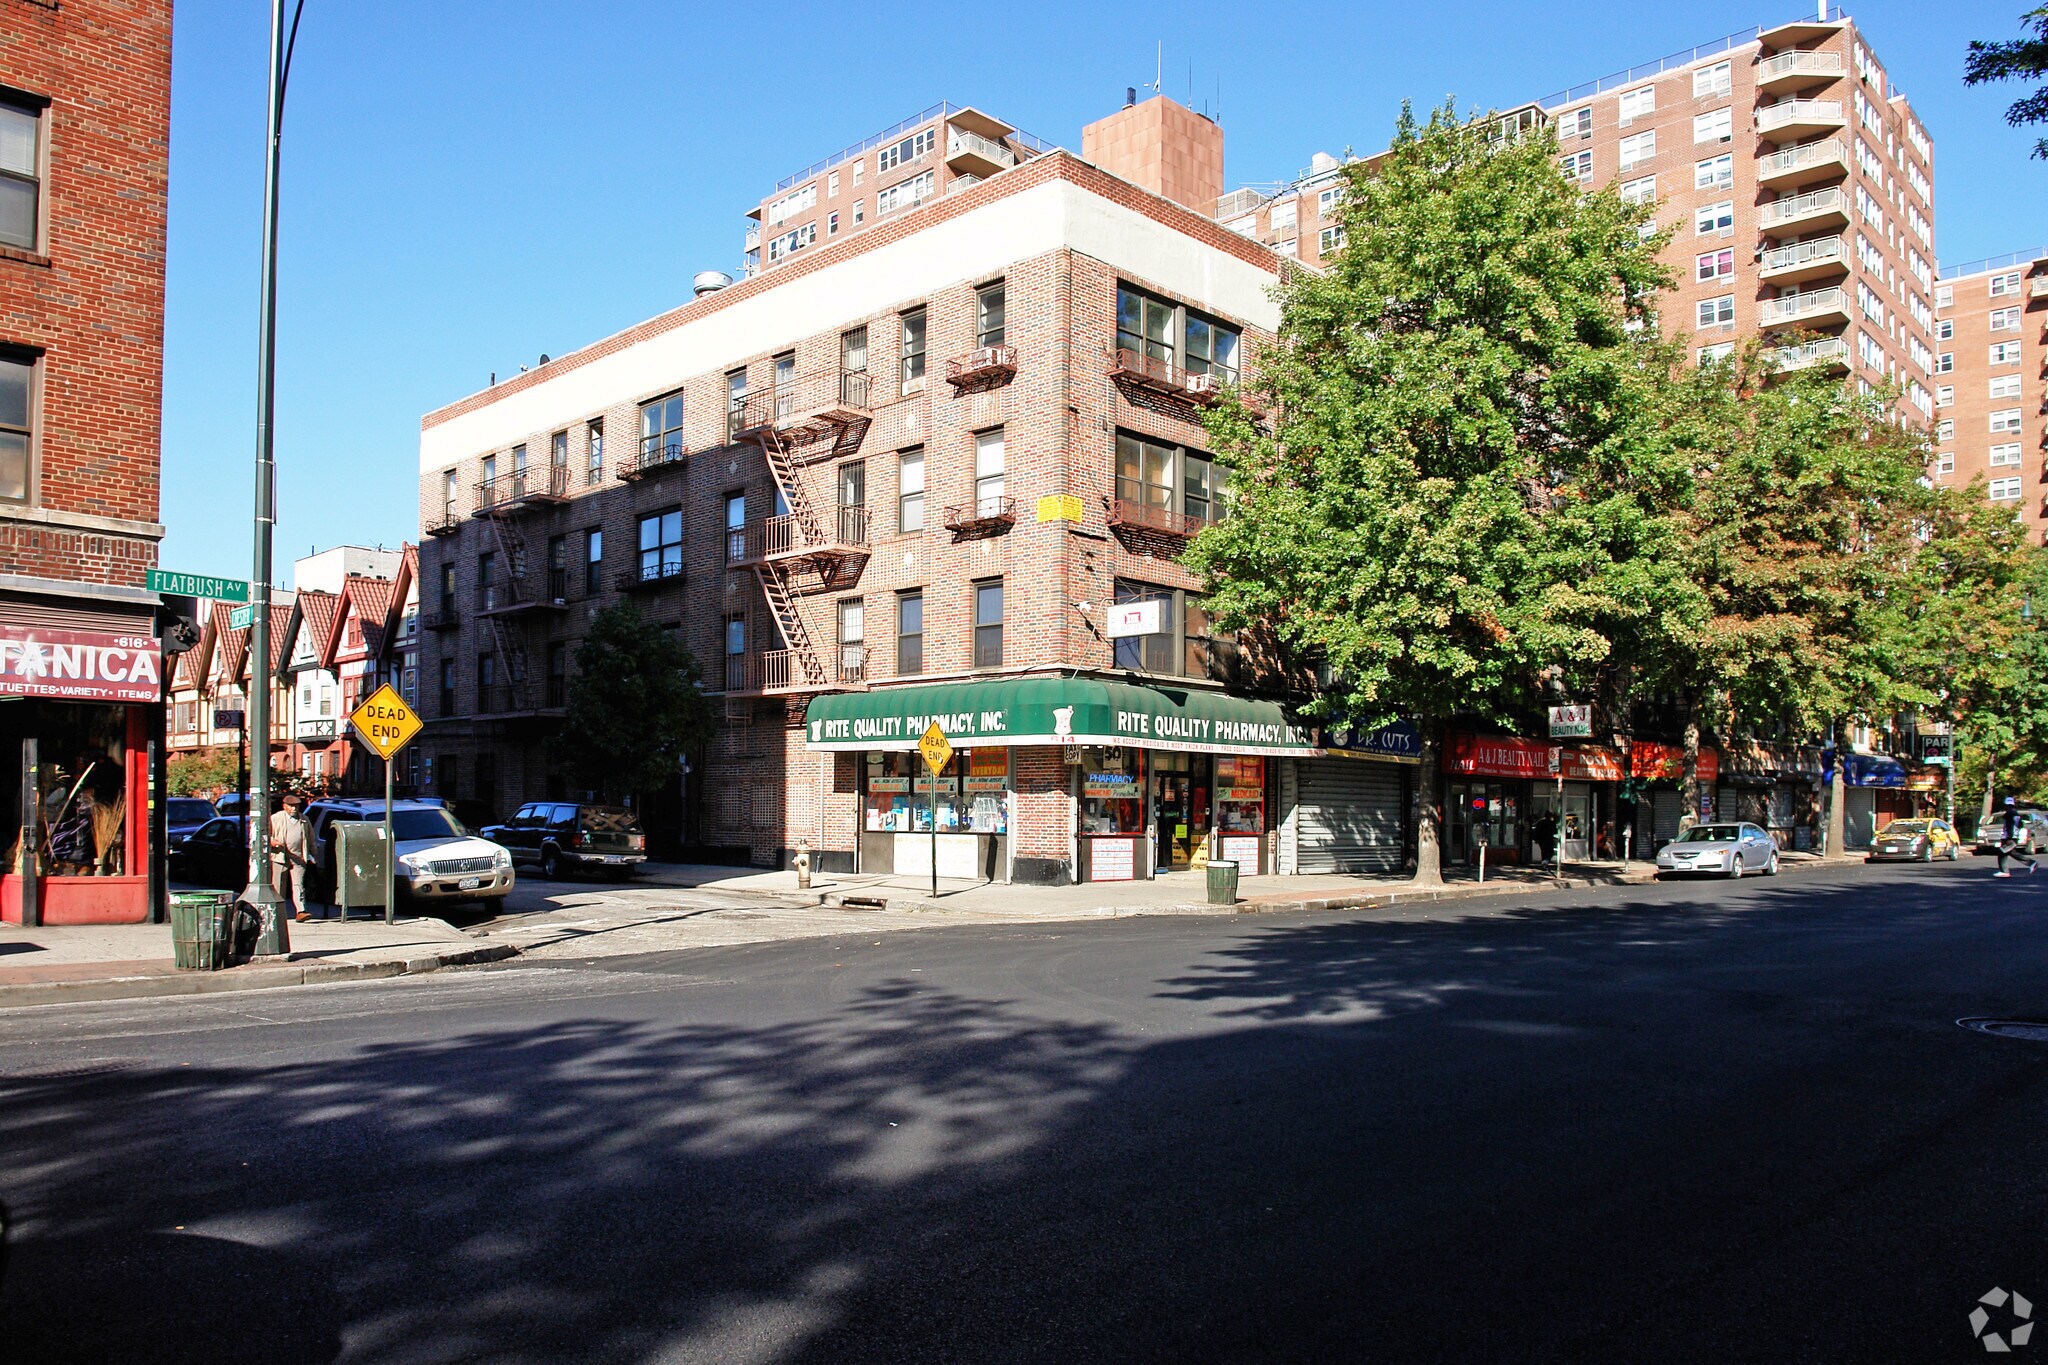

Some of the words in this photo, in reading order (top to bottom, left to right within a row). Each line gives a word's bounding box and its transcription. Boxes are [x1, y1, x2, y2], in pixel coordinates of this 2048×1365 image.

[154, 572, 223, 597] FLATBUSH
[226, 582, 242, 592] AV
[118, 689, 152, 699] ITEMS
[367, 706, 406, 721] DEAD
[1554, 709, 1564, 723] A
[1567, 711, 1575, 722] &
[1579, 708, 1587, 722] J
[825, 719, 850, 738] RITE
[854, 716, 902, 739] QUALITY
[980, 711, 1006, 731] INC.
[1117, 711, 1149, 734] RITE
[1154, 716, 1210, 739] QUALITY
[1215, 720, 1282, 744] PHARMACY,
[1285, 725, 1307, 745] INC.
[1551, 725, 1574, 735] BEAUTY
[372, 725, 401, 738] END
[925, 736, 944, 748] DEAD
[1382, 732, 1411, 750] CUTS
[928, 750, 943, 760] END
[1478, 748, 1485, 763] A
[1486, 748, 1491, 764] &
[1492, 749, 1497, 764] J
[1497, 749, 1526, 767] BEAUTY
[1527, 752, 1545, 767] NAIL
[1579, 754, 1607, 766] ROSA
[972, 766, 1006, 776] EVERYDAY
[1450, 760, 1476, 770] NAIL
[1089, 773, 1134, 784] PHARMACY
[968, 782, 1001, 790] MEDICAID
[1231, 789, 1258, 799] MEDICAID
